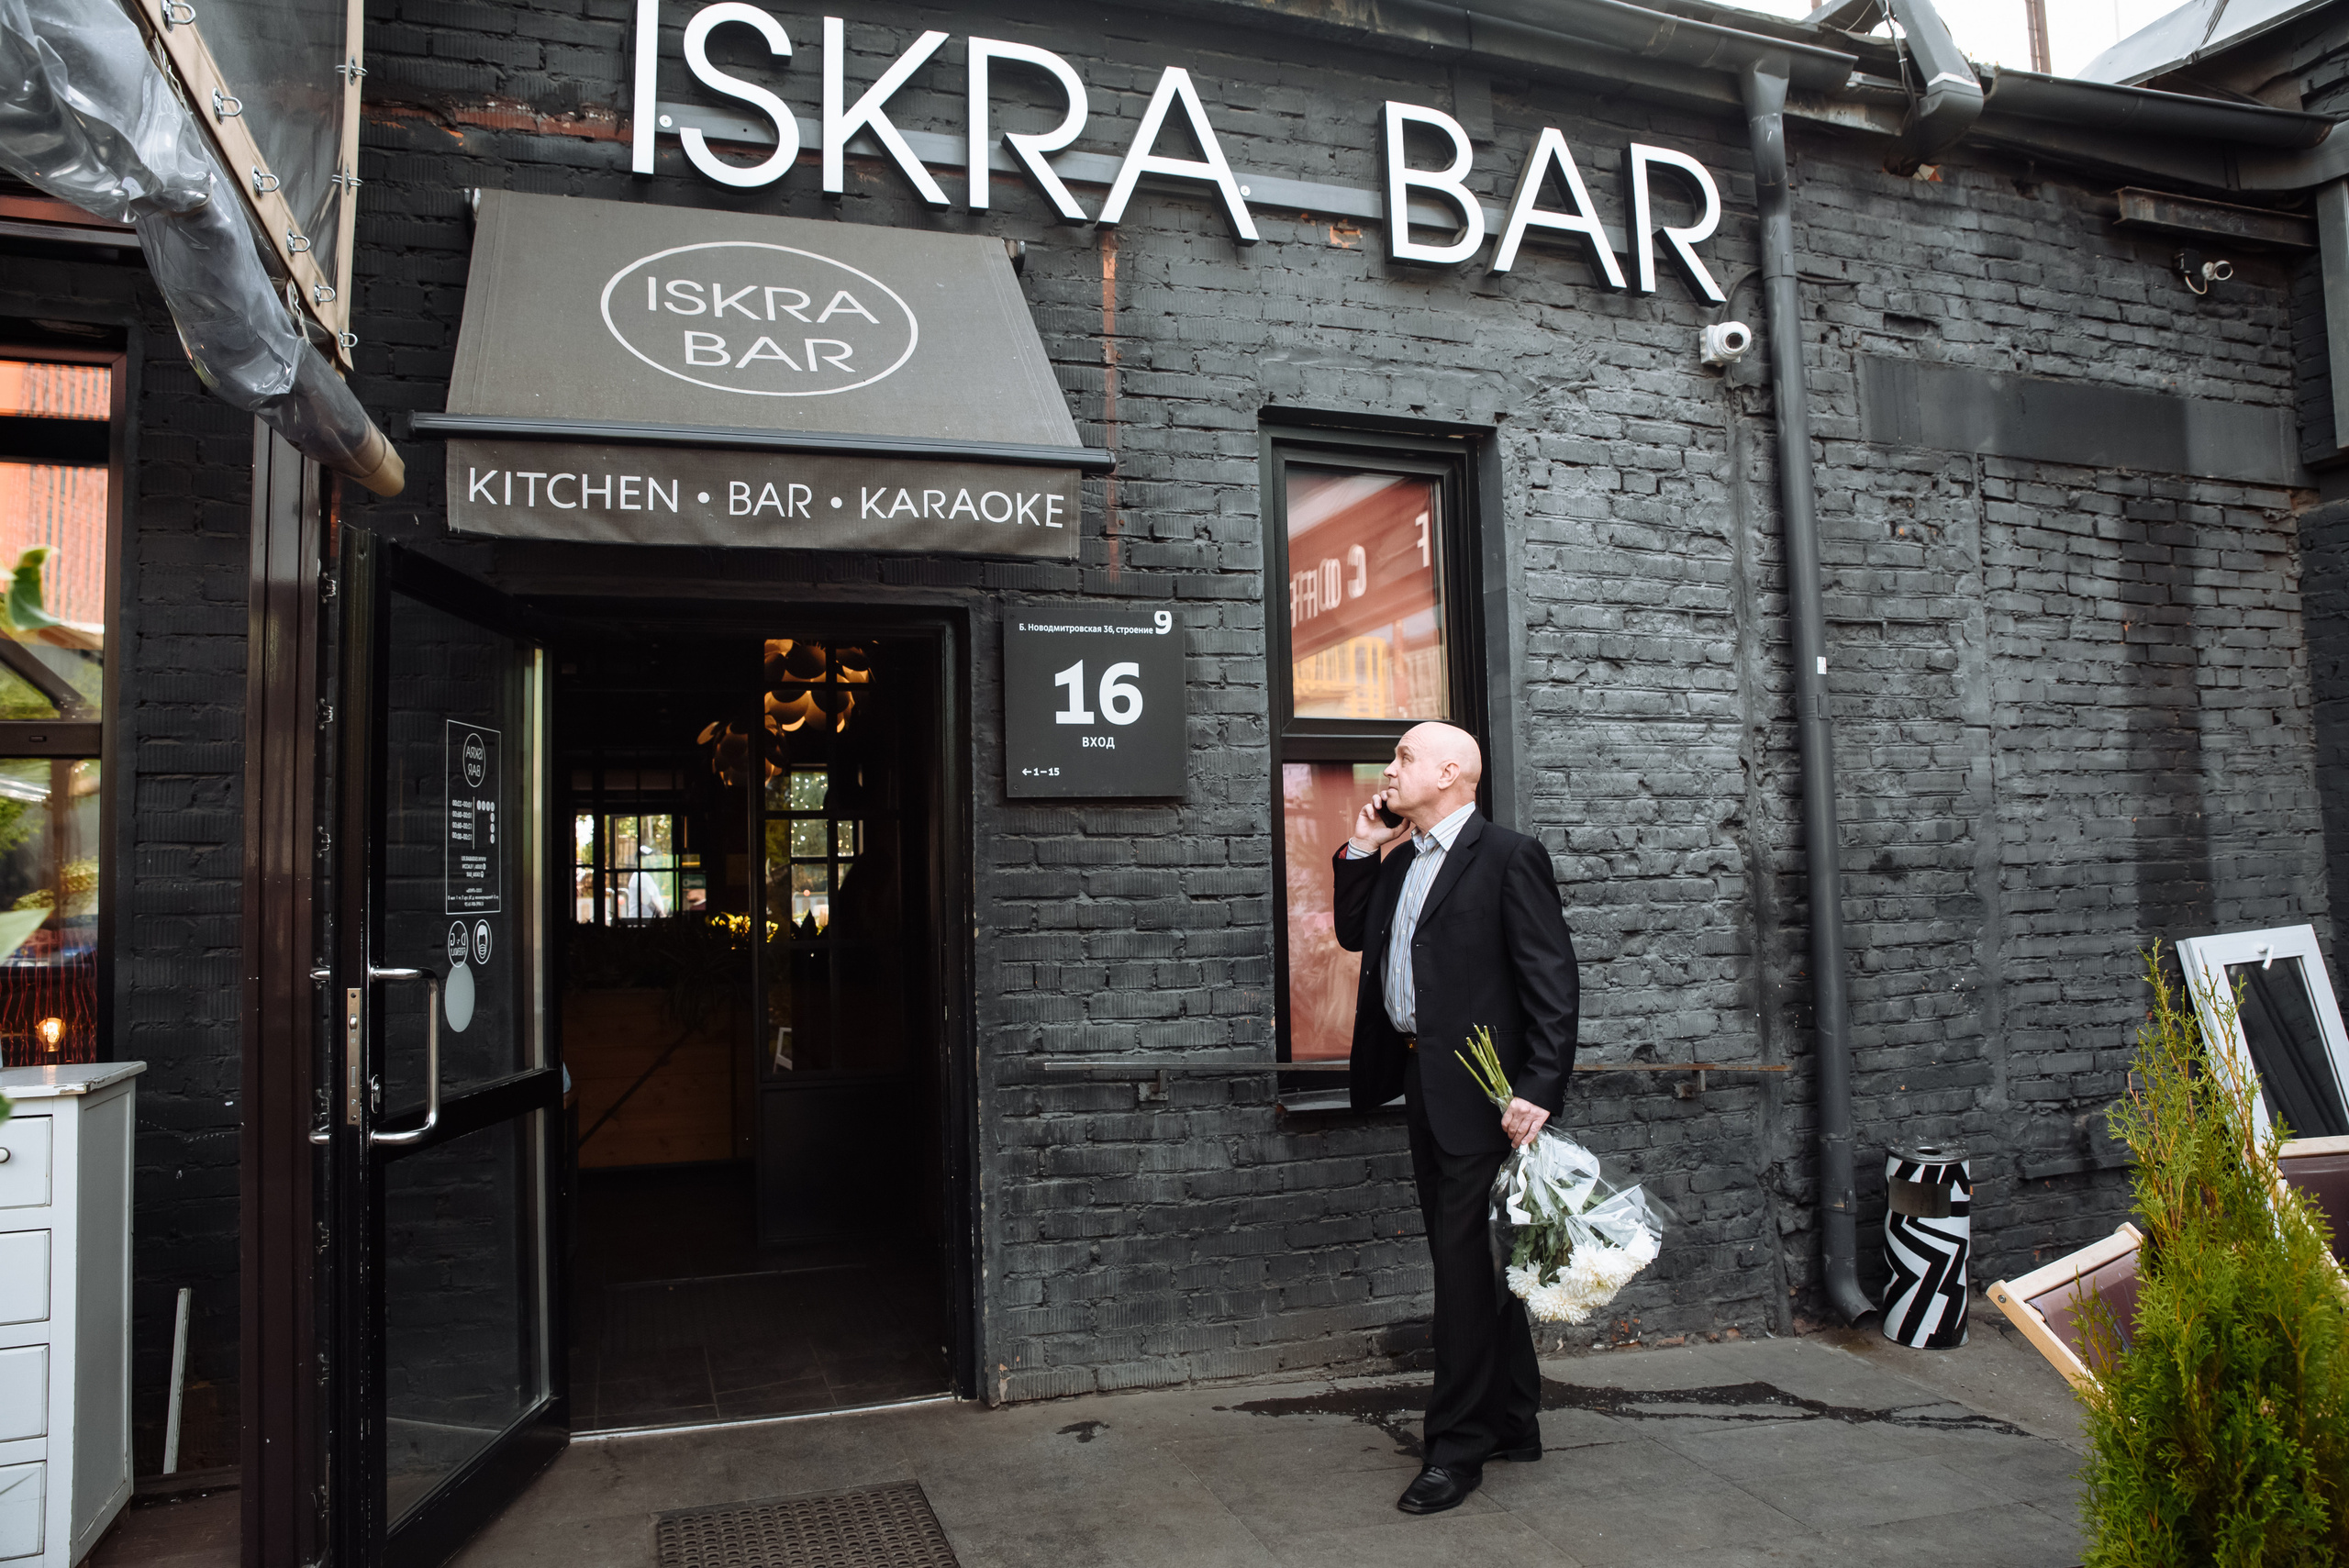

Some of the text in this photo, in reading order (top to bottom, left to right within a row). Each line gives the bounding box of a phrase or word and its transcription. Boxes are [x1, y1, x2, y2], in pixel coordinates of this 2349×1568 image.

[631, 0, 1727, 306] ISKRA BAR
[648, 276, 880, 325] ISKRA
[684, 330, 856, 373] BAR
[468, 467, 1064, 528] KITCHEN BAR KARAOKE
[1019, 623, 1027, 631] Б.
[1028, 623, 1102, 634] Новодмитровская
[1116, 626, 1153, 636] строение
[1154, 610, 1173, 635] 9
[1054, 659, 1143, 726] 16
[1082, 737, 1116, 750] ВХОД
